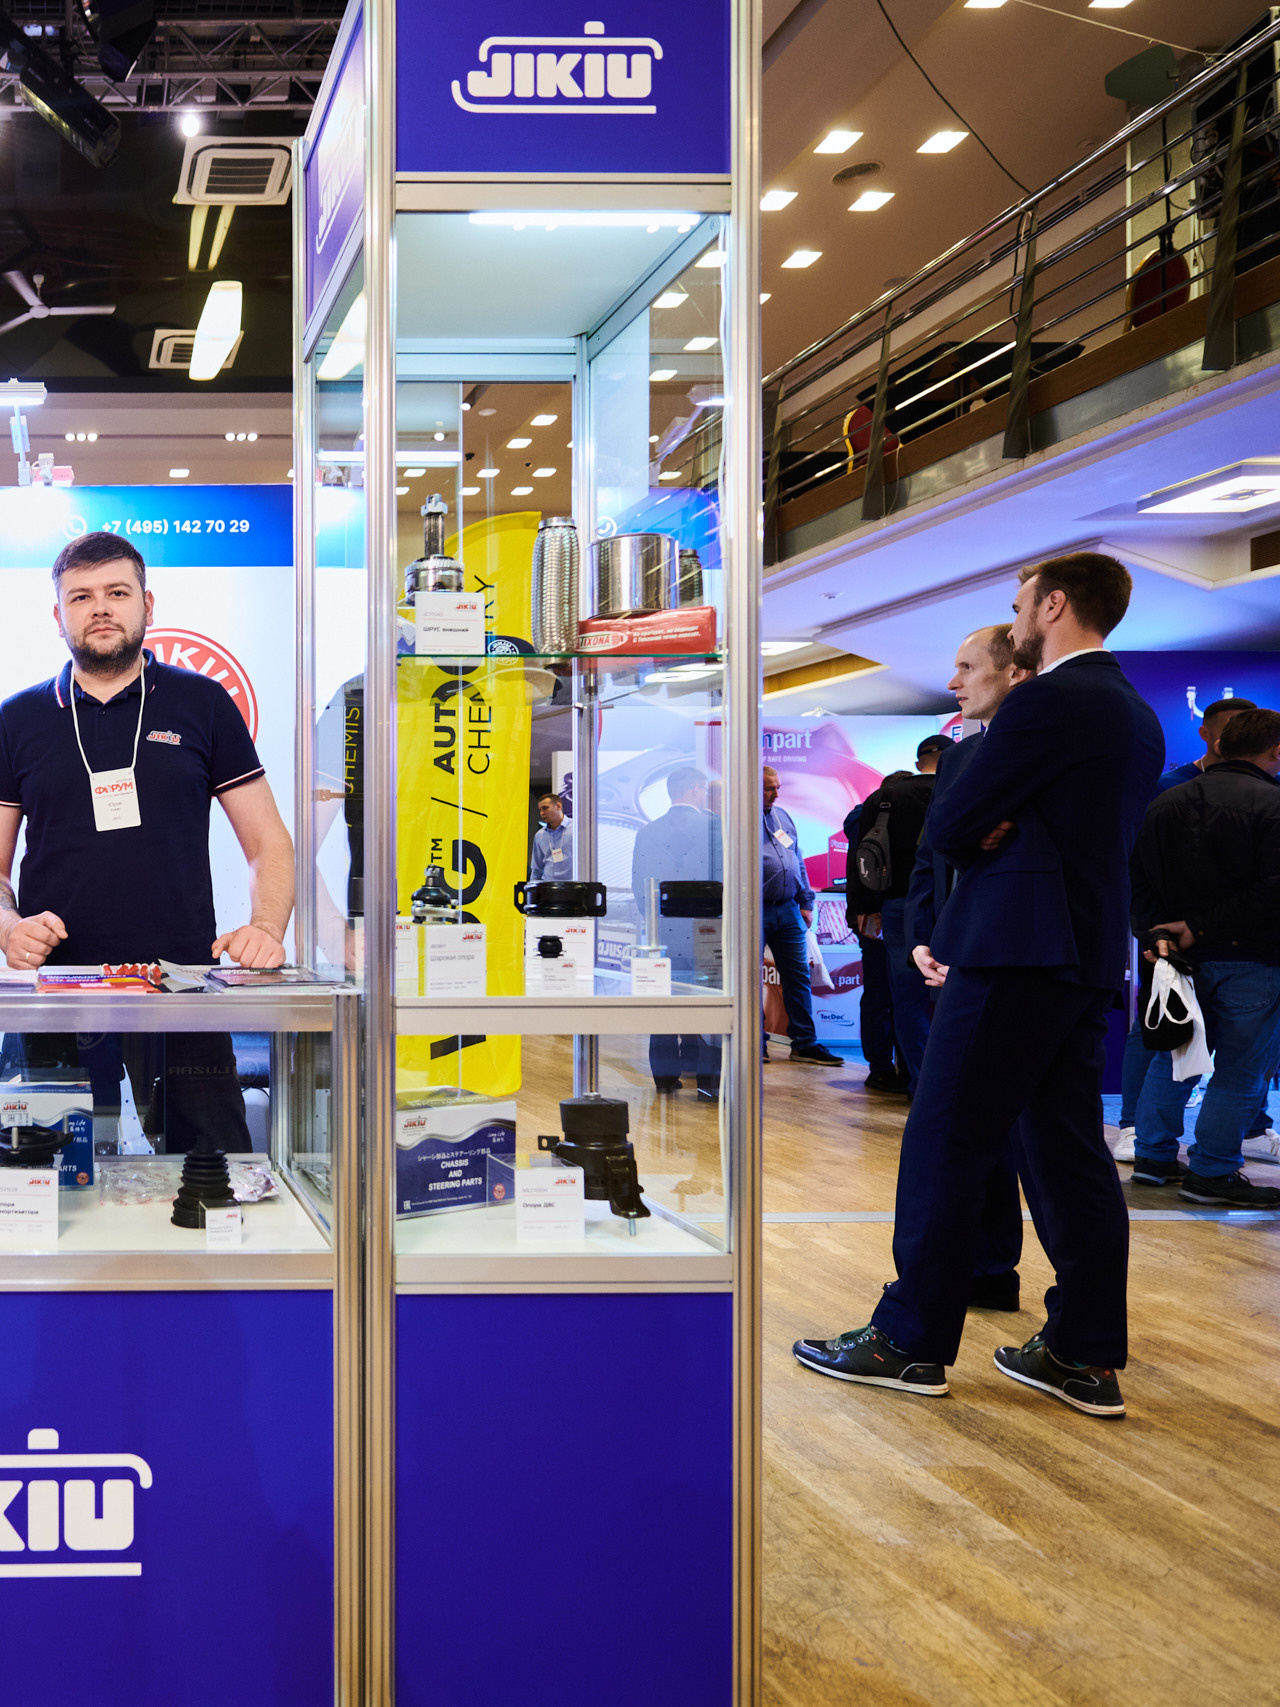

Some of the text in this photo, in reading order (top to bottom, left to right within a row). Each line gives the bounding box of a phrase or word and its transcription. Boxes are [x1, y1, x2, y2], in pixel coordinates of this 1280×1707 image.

[467, 21, 652, 98] JIKIU
[102, 519, 250, 534] +7 (495) 142 70 29
[580, 635, 611, 648] TIXONA
[440, 1158, 469, 1169] CHASSIS
[448, 1169, 463, 1178] AND
[428, 1177, 483, 1191] STEERING PARTS
